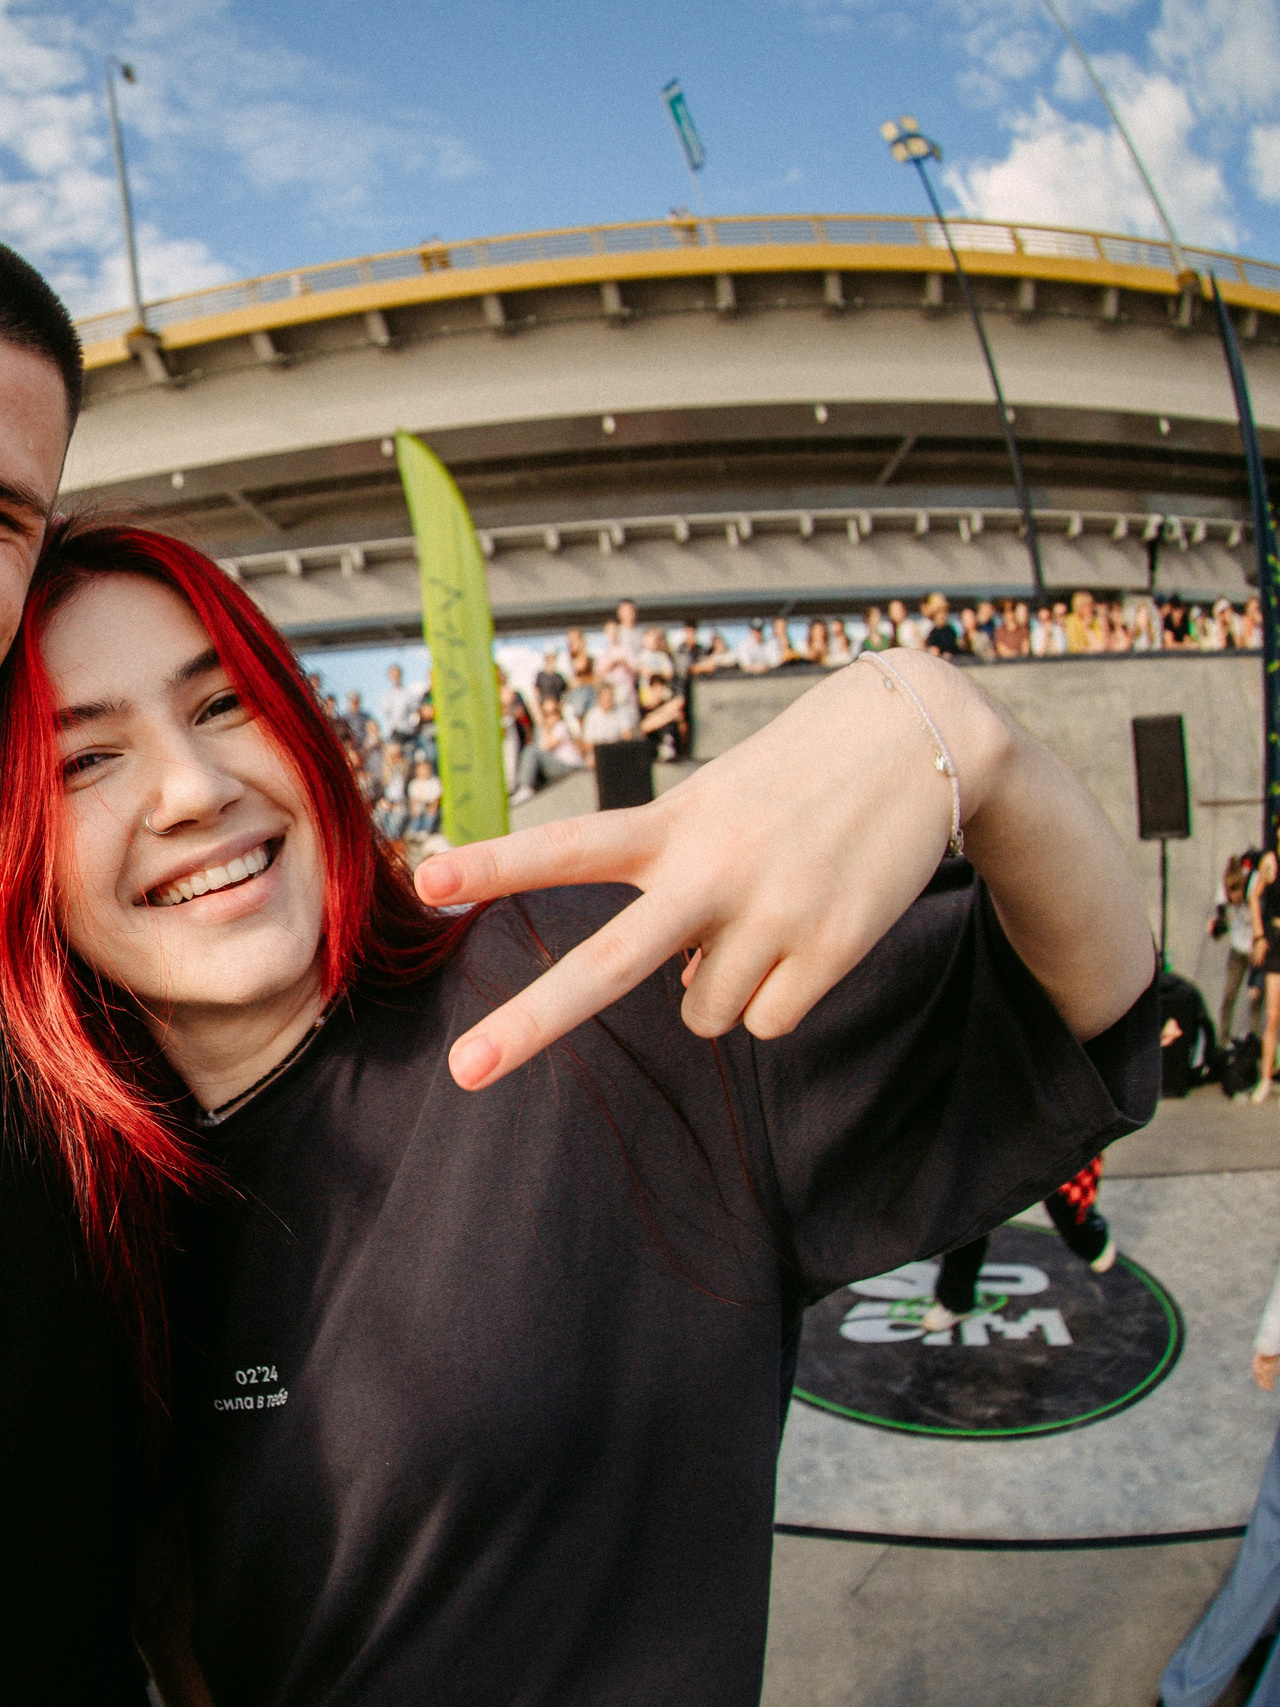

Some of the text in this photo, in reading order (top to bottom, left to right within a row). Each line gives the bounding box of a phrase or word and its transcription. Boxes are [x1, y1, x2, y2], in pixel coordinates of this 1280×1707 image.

[235, 1365, 279, 1385] 02'24
[214, 1396, 255, 1411] сила
[256, 1395, 265, 1409] в
